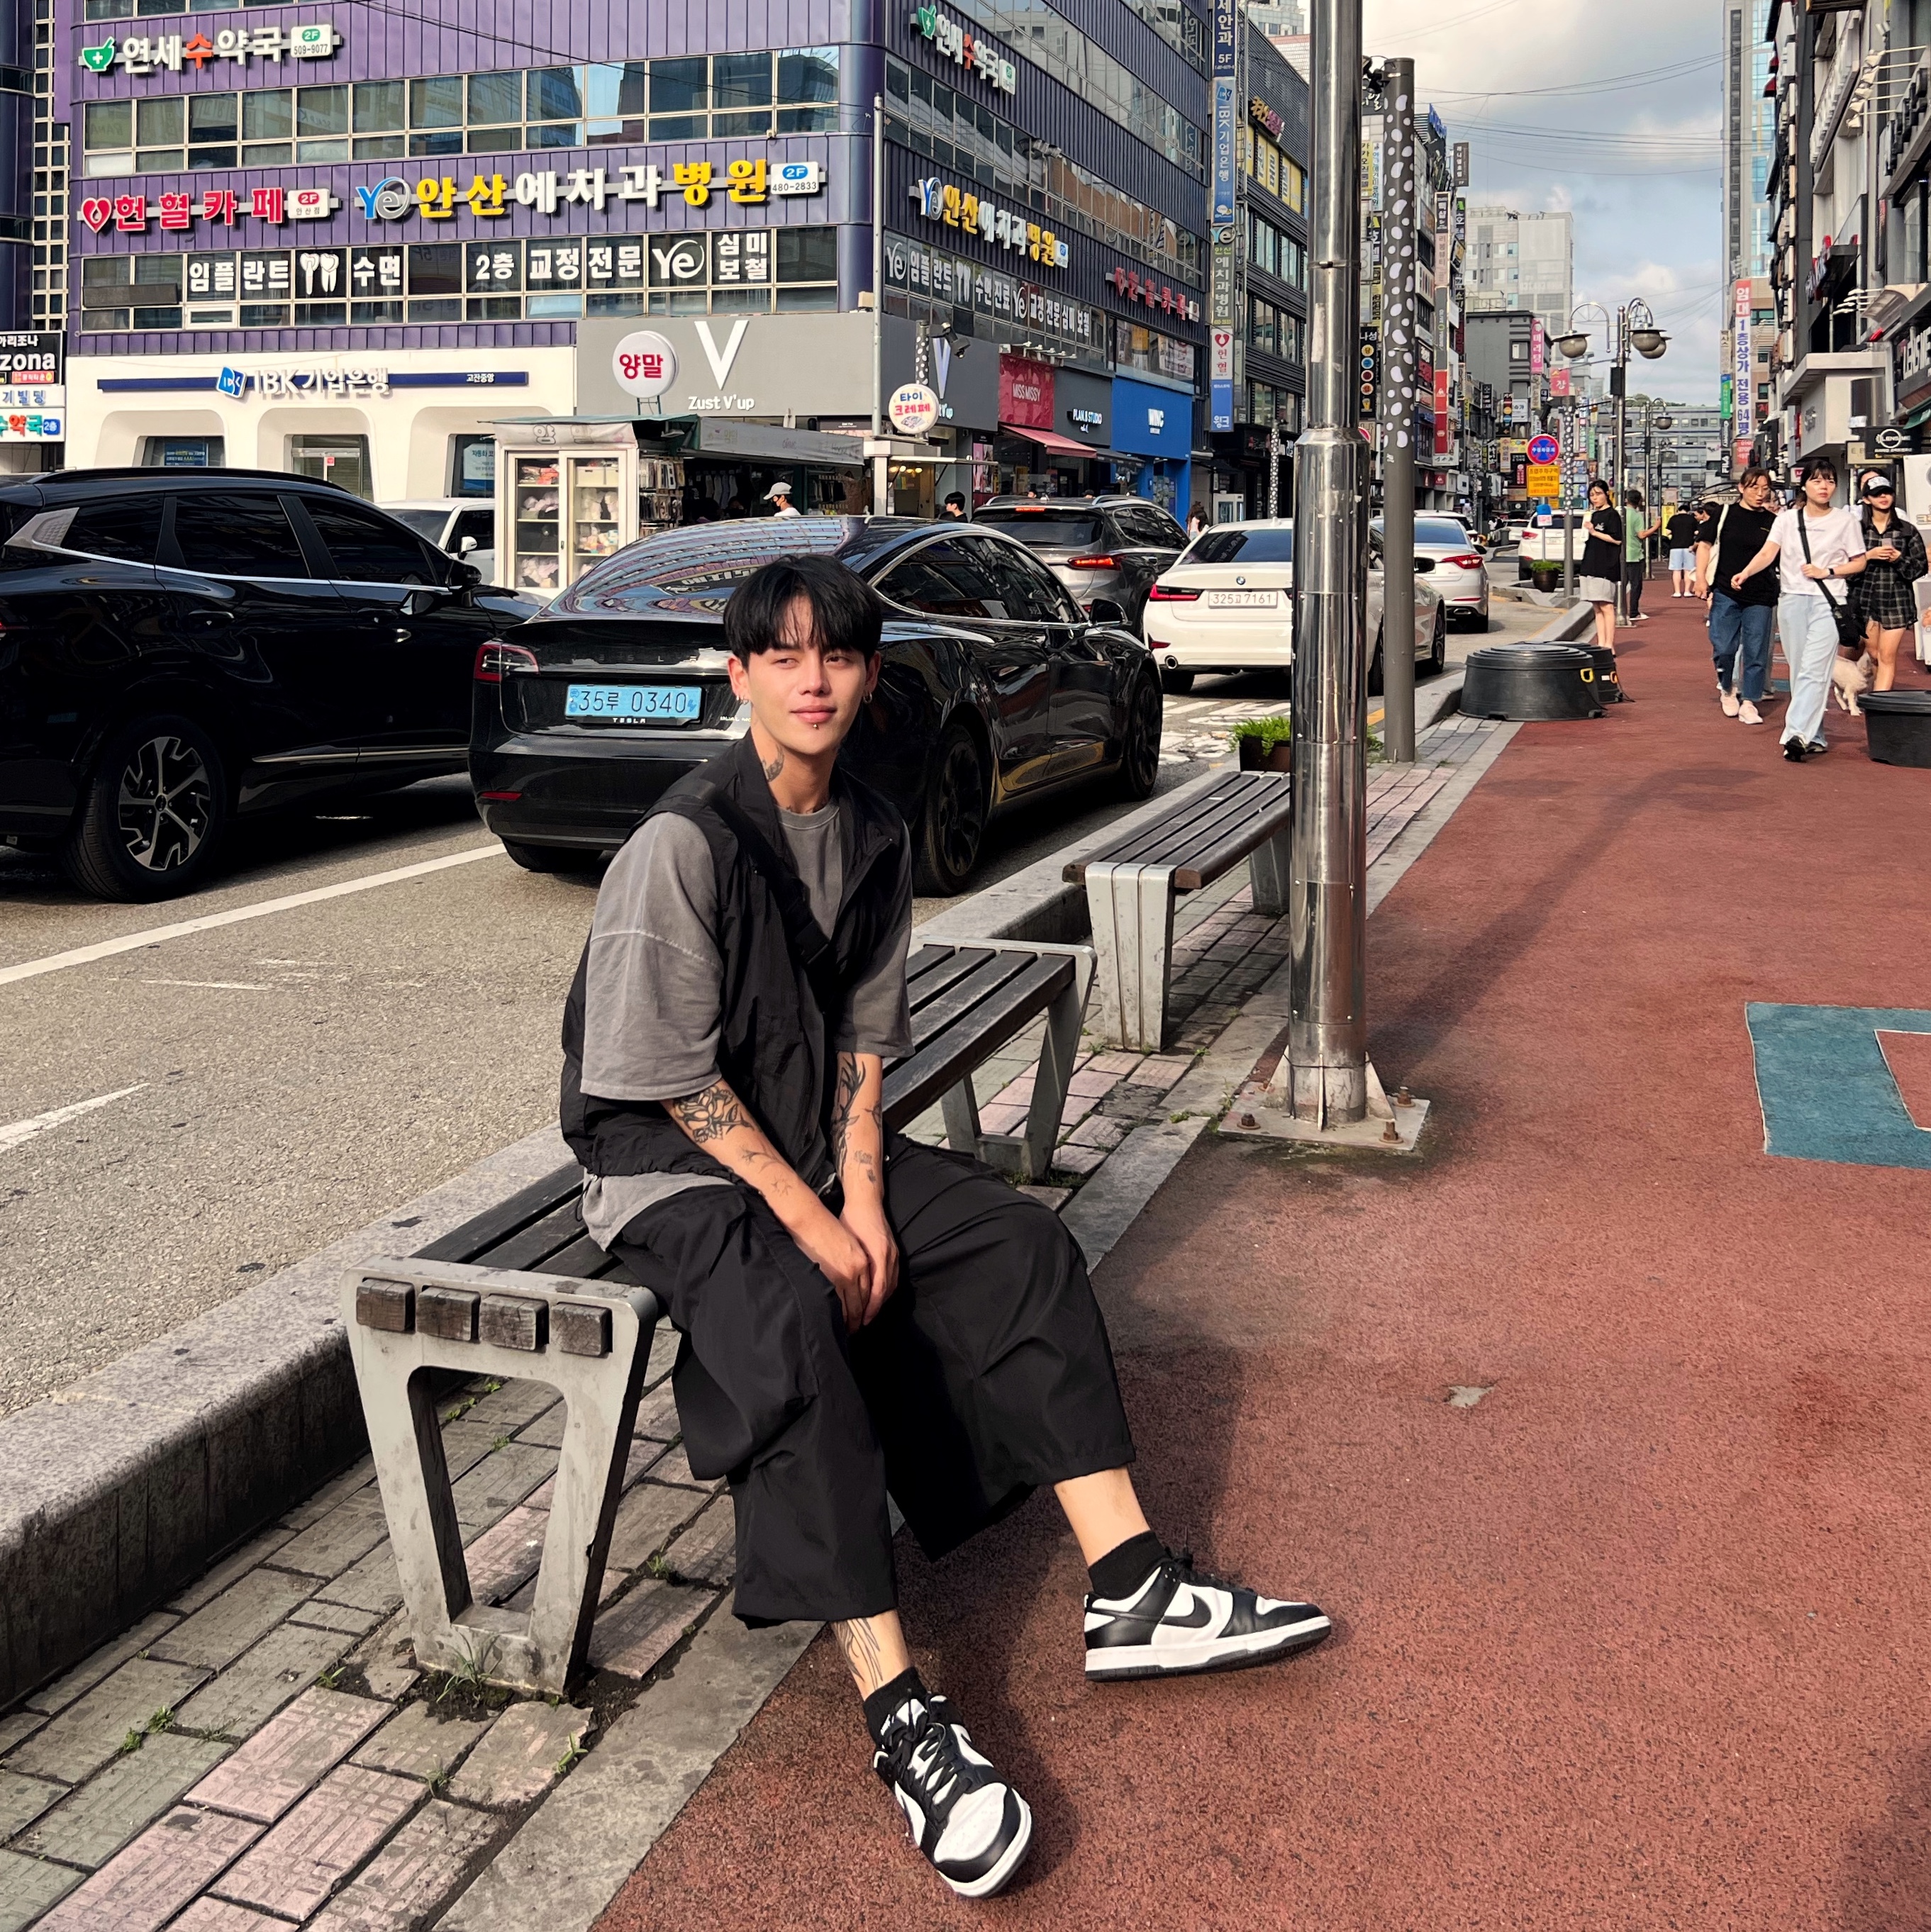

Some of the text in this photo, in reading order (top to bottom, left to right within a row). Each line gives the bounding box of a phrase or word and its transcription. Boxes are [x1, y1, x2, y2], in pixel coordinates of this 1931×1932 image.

[304, 31, 318, 40] 2F
[123, 26, 282, 74] 연세수약국
[294, 44, 328, 55] 509-9077
[936, 14, 999, 88] 연세수약국
[1218, 54, 1232, 63] 5F
[786, 167, 805, 178] 2F
[300, 194, 317, 203] 2F
[355, 176, 411, 220] Ye
[416, 159, 767, 219] 안산예치과병원
[772, 181, 817, 194] 480-2833
[114, 186, 284, 233] 헌혈카페
[296, 207, 321, 216] 안산점
[943, 184, 1055, 267] 안산예치과병원
[718, 233, 767, 256] 심미
[189, 259, 289, 292] 임플란트
[354, 254, 401, 286] 수면
[476, 252, 515, 281] 2층
[718, 258, 767, 281] 보철
[910, 250, 952, 291] 임플란트
[1736, 287, 1749, 315] 임대
[619, 353, 664, 379] 양말
[254, 368, 389, 394] IBK기업은행
[1737, 379, 1749, 406] 전용
[689, 396, 722, 411] Zust
[900, 391, 923, 402] 타이
[894, 403, 931, 416] 크레페
[1244, 593, 1271, 604] 7161
[631, 691, 687, 713] 0340
